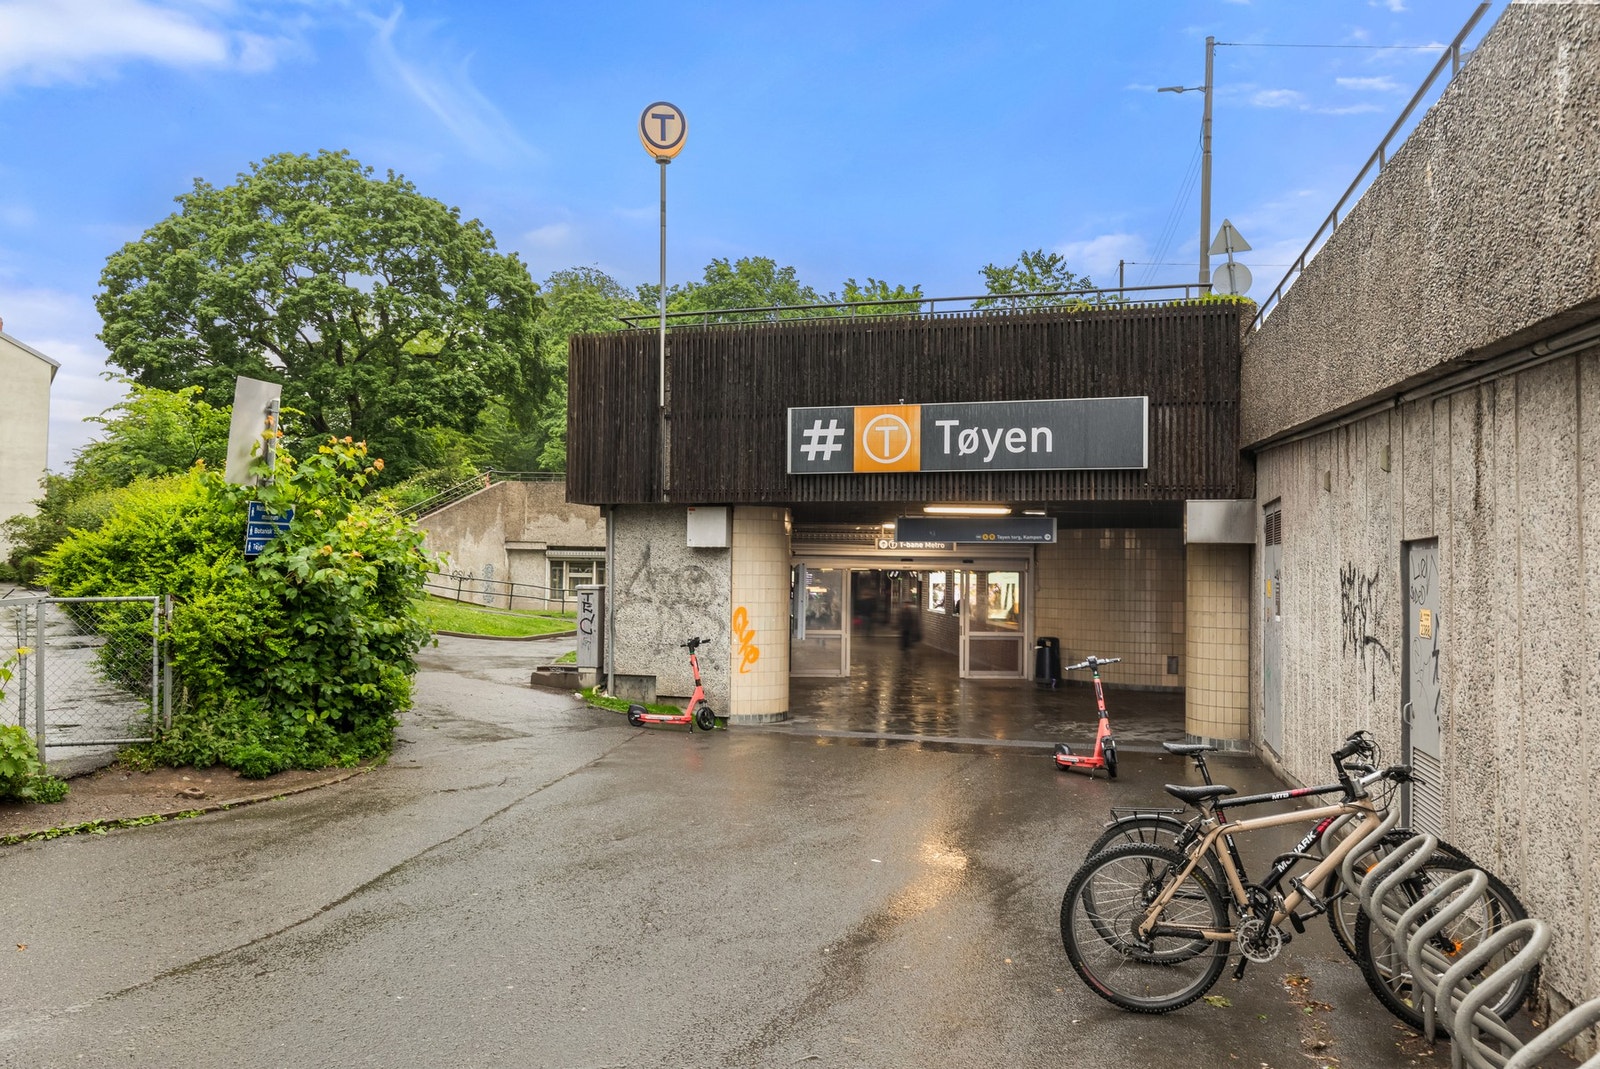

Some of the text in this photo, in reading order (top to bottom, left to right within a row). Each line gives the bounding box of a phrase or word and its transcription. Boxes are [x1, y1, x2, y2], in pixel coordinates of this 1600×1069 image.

[651, 113, 675, 141] T
[875, 426, 899, 457] T
[935, 419, 1053, 463] Tøyen
[899, 541, 923, 549] T-bane
[924, 541, 945, 549] Metro
[1271, 792, 1290, 800] MTB
